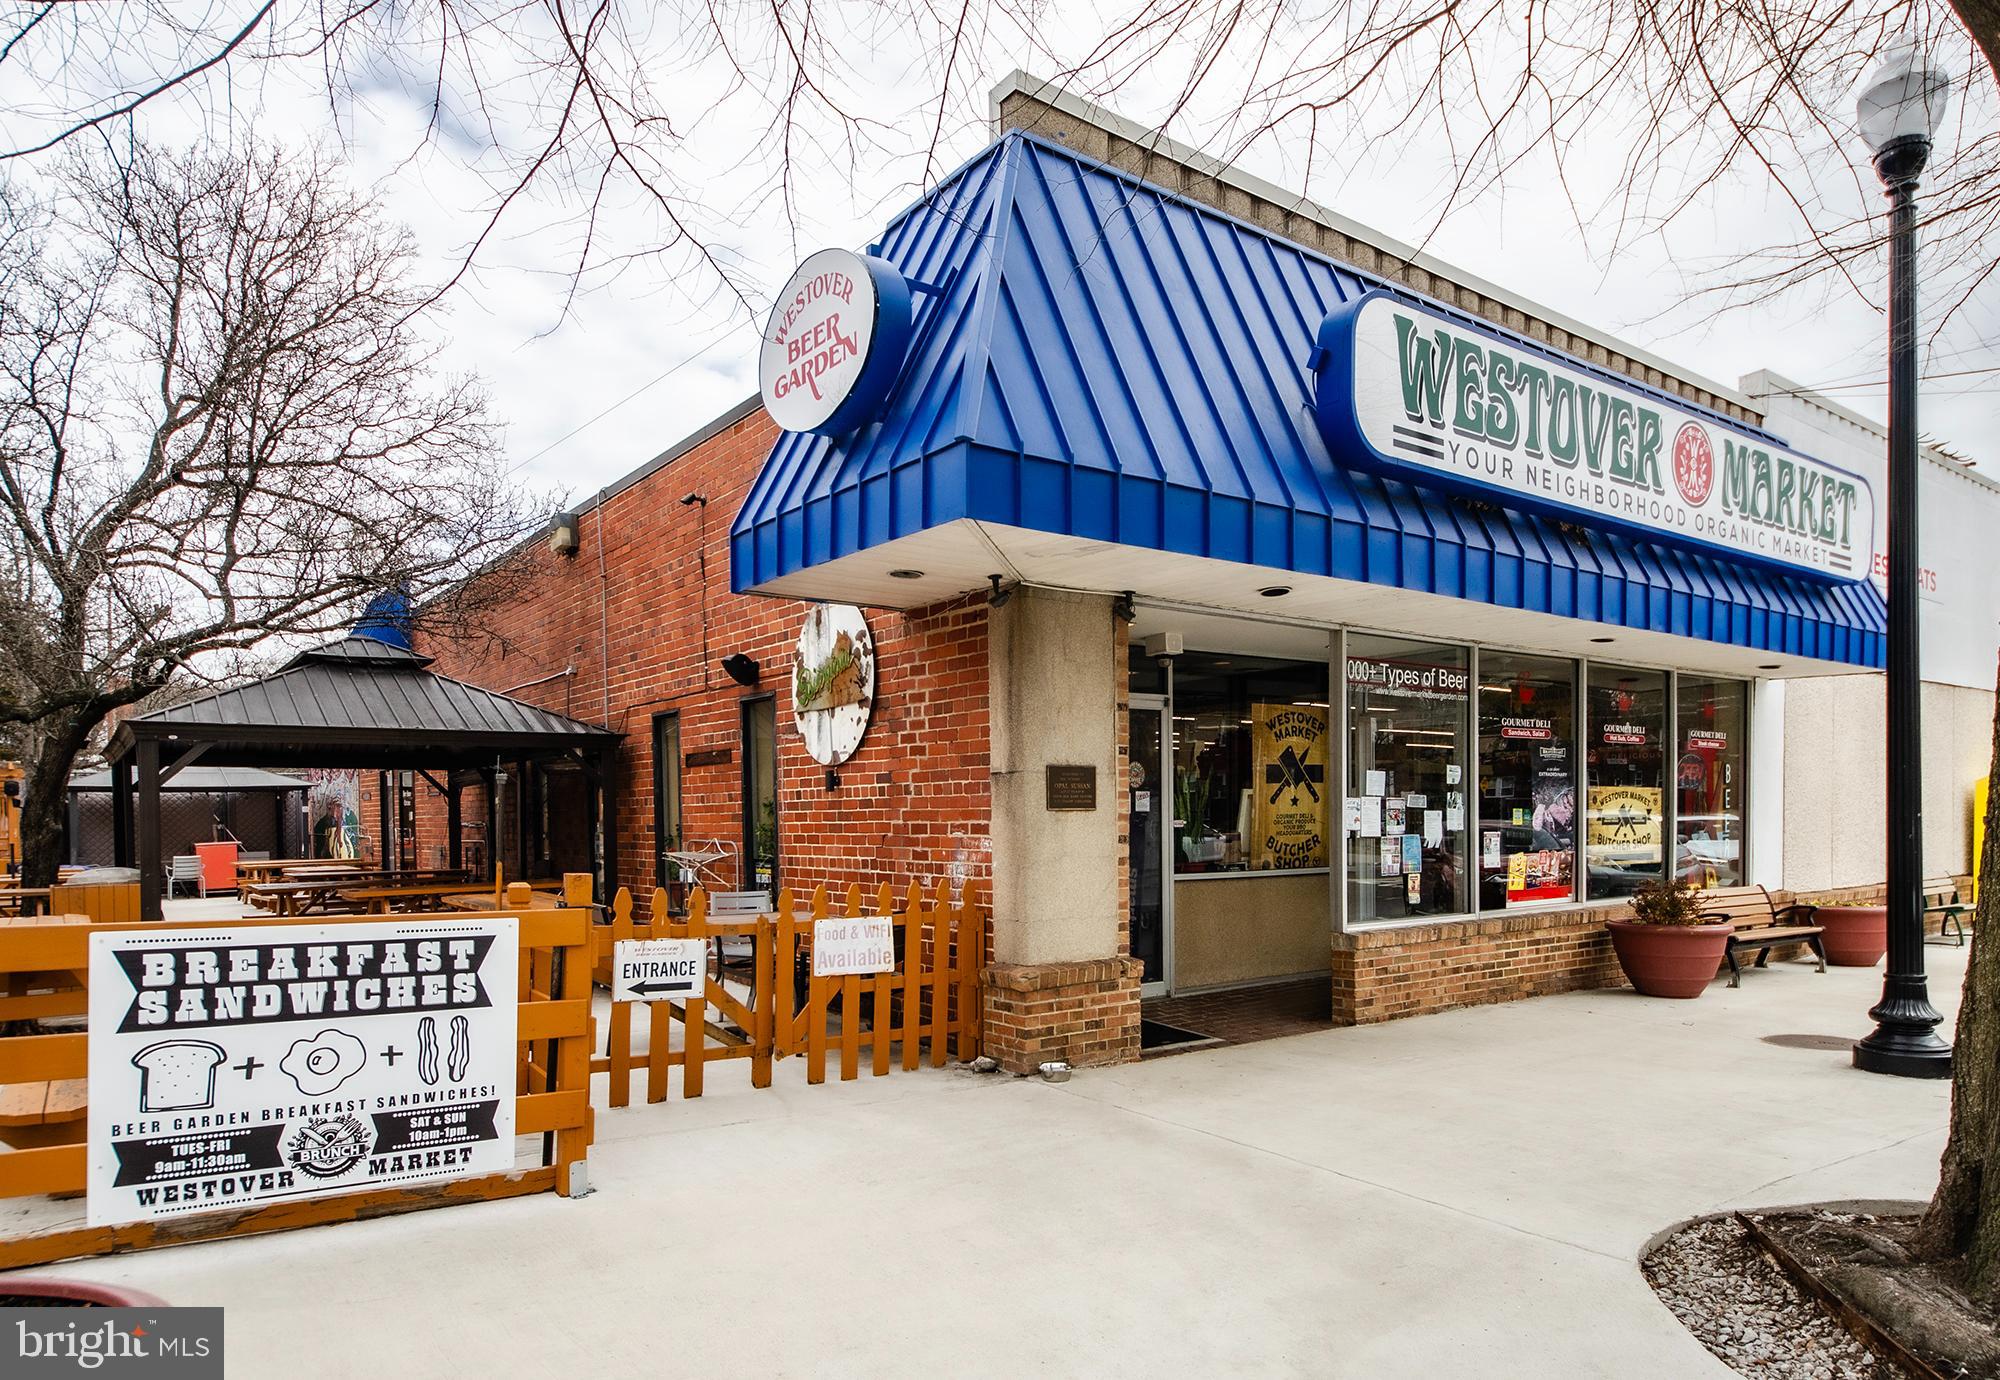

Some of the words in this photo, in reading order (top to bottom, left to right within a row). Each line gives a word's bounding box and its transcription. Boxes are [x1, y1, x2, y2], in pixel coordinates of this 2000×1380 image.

[775, 272, 853, 346] WESTOVER
[788, 312, 843, 365] BEER
[774, 331, 858, 401] GARDEN
[1393, 312, 1665, 496] WESTOVER
[1721, 438, 1857, 549] MARKET
[1448, 441, 1514, 481] YOUR
[1527, 463, 1686, 528] NEIGHBORHOOD
[1695, 513, 1766, 549] ORGANIC
[1773, 535, 1828, 567] MARKET
[1380, 663, 1419, 687] Types
[1423, 668, 1435, 686] of
[1439, 668, 1468, 690] Beer
[1265, 711, 1326, 735] WESTOVER
[1501, 717, 1535, 728] GOURMET
[1536, 719, 1551, 728] DELI
[1603, 723, 1632, 733] GOURMET
[1632, 725, 1645, 734] DELI
[1274, 725, 1318, 743] MARKET
[1690, 730, 1714, 739] GOURMET
[1715, 731, 1726, 740] DELI
[1599, 791, 1629, 806] WESTOVER
[1630, 792, 1651, 806] MARKET
[1265, 834, 1321, 857] BUTCHER
[1597, 833, 1632, 851] BUTCHER
[1632, 832, 1651, 849] SHOP
[1274, 855, 1309, 868] SHOP
[817, 926, 846, 942] Food
[851, 925, 858, 939] &
[142, 940, 476, 988] BREAKFAST
[817, 947, 891, 969] Available
[623, 960, 697, 979] ENTRANCE
[137, 973, 478, 1026] SANDWICHES
[112, 1119, 161, 1138] BEER
[174, 1110, 250, 1132] GARDEN
[262, 1098, 367, 1122] BREAKFAST
[377, 1084, 497, 1109] SANDWICHES!
[409, 1115, 434, 1129] SAT
[435, 1114, 443, 1127] &
[445, 1112, 467, 1126] SUN
[409, 1124, 468, 1143] 10am-1pm
[171, 1139, 231, 1157] TUES-FRI
[300, 1145, 360, 1162] BRUNCH
[154, 1152, 247, 1175] 9am-11:30am
[137, 1171, 295, 1206] WESTOVER
[368, 1147, 473, 1176] MARKET
